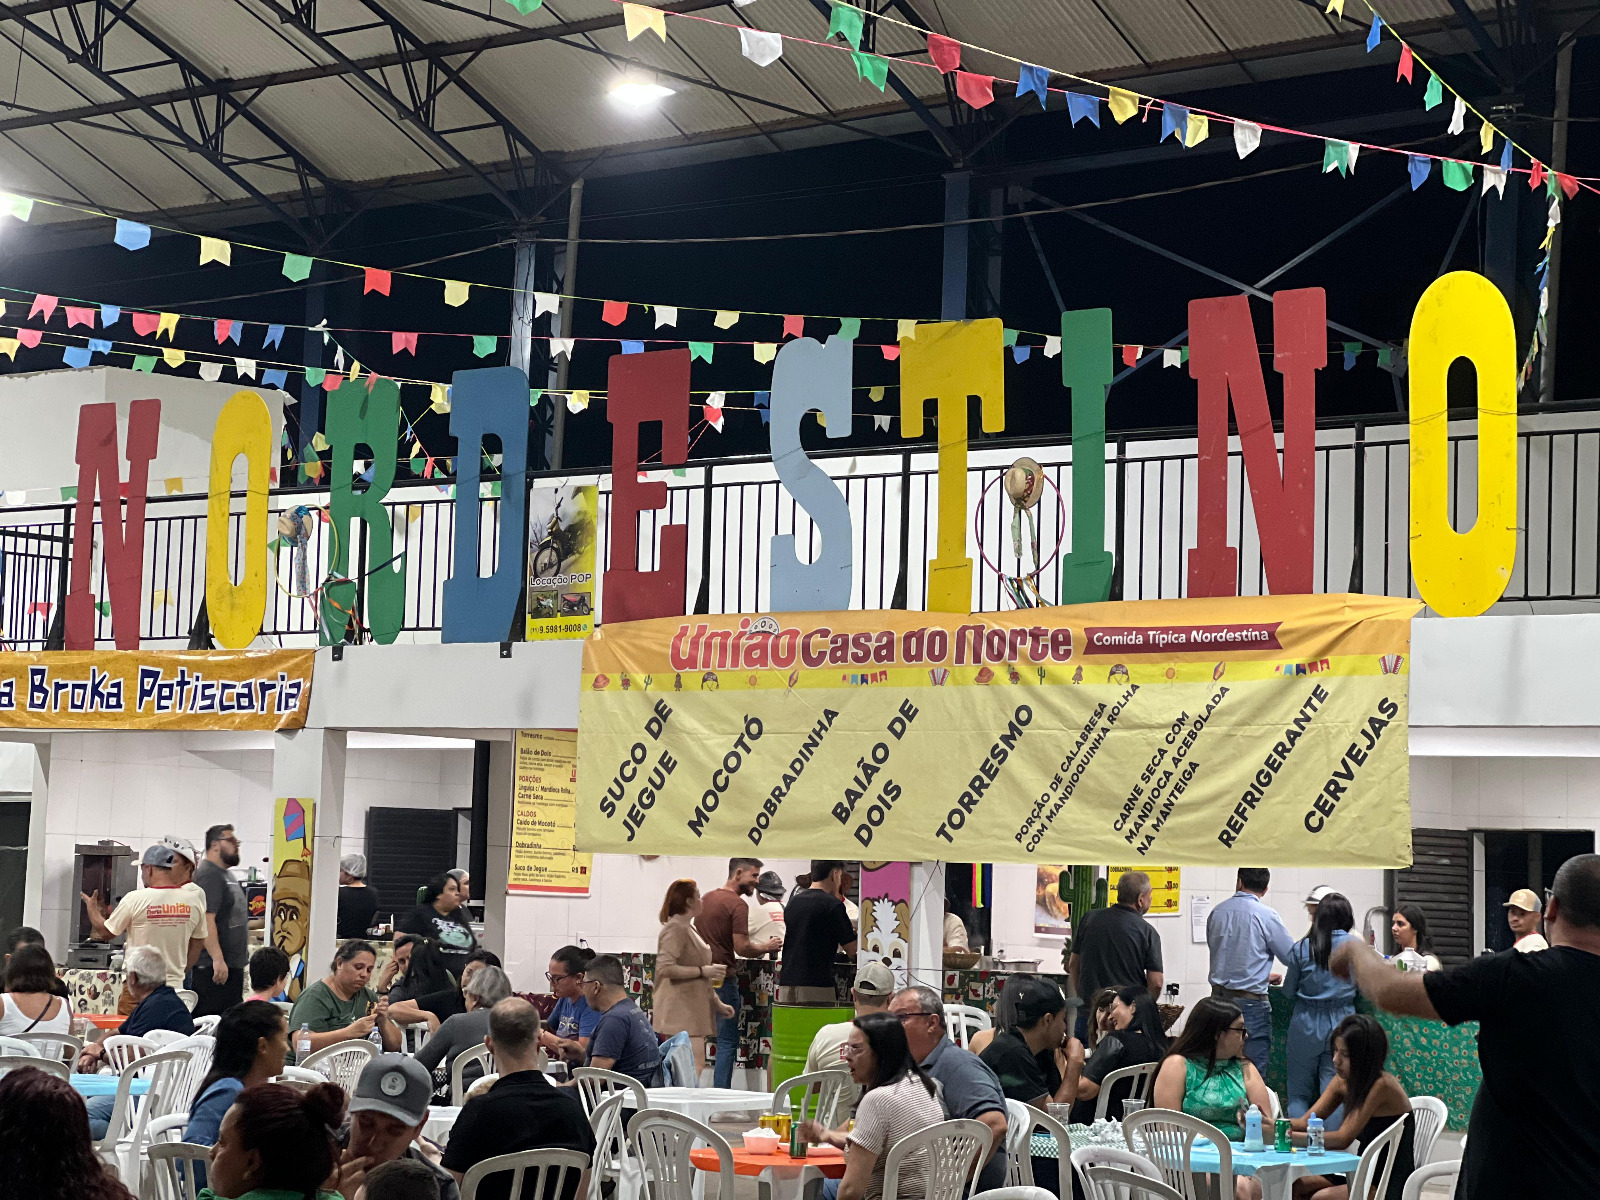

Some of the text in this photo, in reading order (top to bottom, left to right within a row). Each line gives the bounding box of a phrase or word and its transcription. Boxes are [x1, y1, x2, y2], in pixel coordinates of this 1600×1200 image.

[64, 270, 1517, 651] NORDESTINO
[530, 573, 592, 588] Locação POP
[539, 623, 582, 634] 9.5981-9008
[670, 617, 1072, 671] União Casa do Norte
[1093, 631, 1143, 646] Comida
[1190, 628, 1269, 643] Nordestina
[27, 665, 125, 713] Broka
[136, 664, 303, 715] Petiscaria
[520, 747, 533, 755] Baião
[540, 749, 552, 757] Dois
[521, 731, 543, 740] Torresmo
[599, 698, 673, 819] SUCO DE
[831, 697, 919, 825] BAIÃO DE
[1025, 683, 1141, 853] COM MANDIOQUINHA ROLHA
[1124, 686, 1230, 844] MANDIOCA ACEBOLADA
[1217, 683, 1330, 849] REFRIGERANTE
[1303, 697, 1399, 834] CERVEJAS
[517, 792, 544, 801] Carne Seca
[518, 775, 542, 784] PORÇÕES
[622, 749, 678, 842] JEGUE
[686, 713, 764, 838] MOCOTÓ
[746, 708, 839, 846] DOBRADINHA
[935, 704, 1033, 844] TORRESMO
[1014, 702, 1107, 843] PORÇÃO DE CALABRESA
[1113, 710, 1190, 832] CARNE SECA COM
[516, 810, 537, 818] CALDOS
[516, 818, 531, 826] Caldo
[853, 778, 902, 848] DOIS
[1136, 833, 1156, 856] NA
[1151, 761, 1200, 833] MANTEIGA
[514, 863, 526, 872] Suco
[533, 865, 548, 873] Jegue
[515, 841, 542, 849] Dobradinha
[162, 902, 191, 914] União
